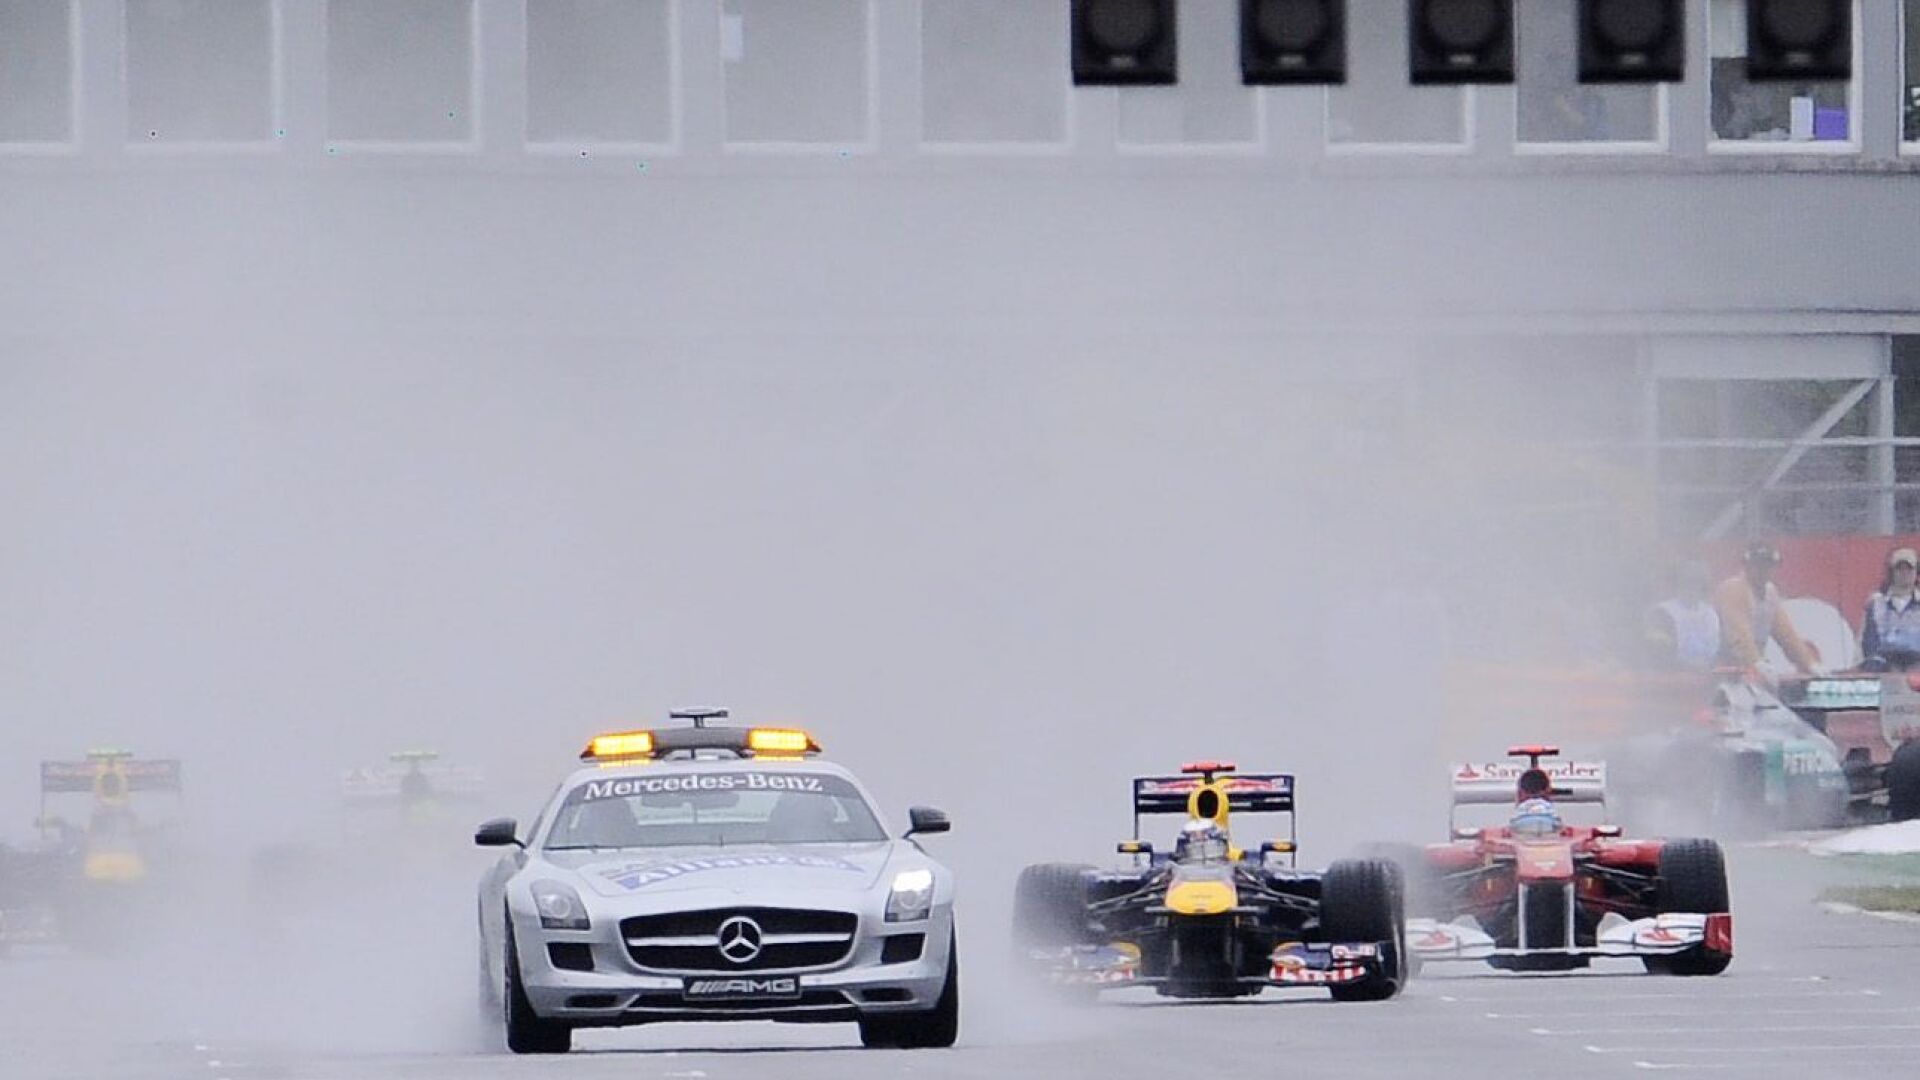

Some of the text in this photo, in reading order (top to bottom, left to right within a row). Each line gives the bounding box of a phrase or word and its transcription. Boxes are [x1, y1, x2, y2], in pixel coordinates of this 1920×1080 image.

[1484, 761, 1600, 777] Sannder
[584, 773, 823, 800] Mercedes-Benz
[724, 979, 796, 992] AMG
